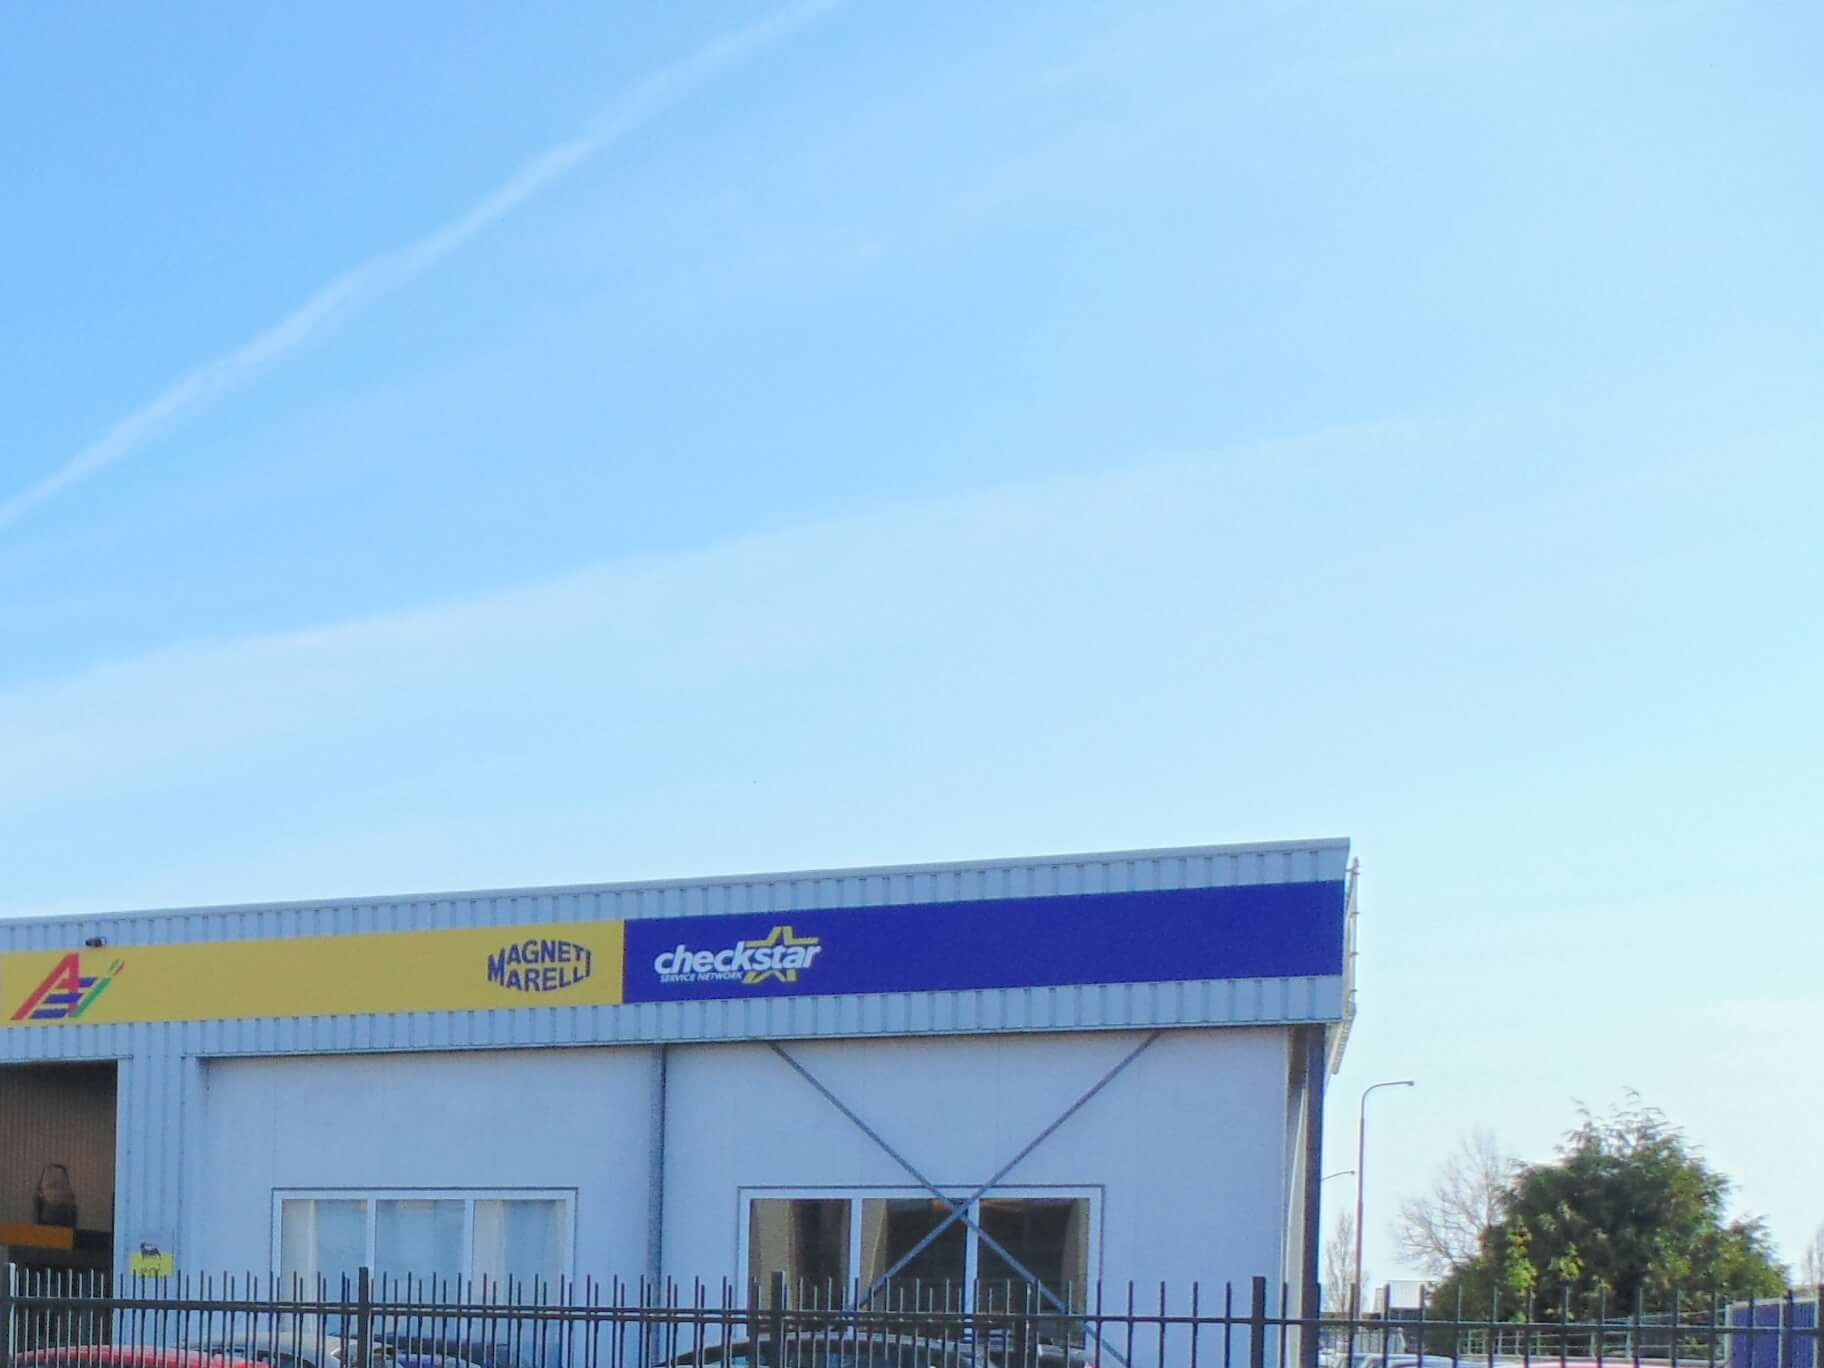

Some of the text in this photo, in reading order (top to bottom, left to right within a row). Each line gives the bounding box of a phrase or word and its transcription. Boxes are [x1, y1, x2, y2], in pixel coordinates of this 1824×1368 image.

[487, 938, 591, 967] MAGNETI
[654, 941, 822, 975] checkstar
[487, 963, 591, 992] MARELLI
